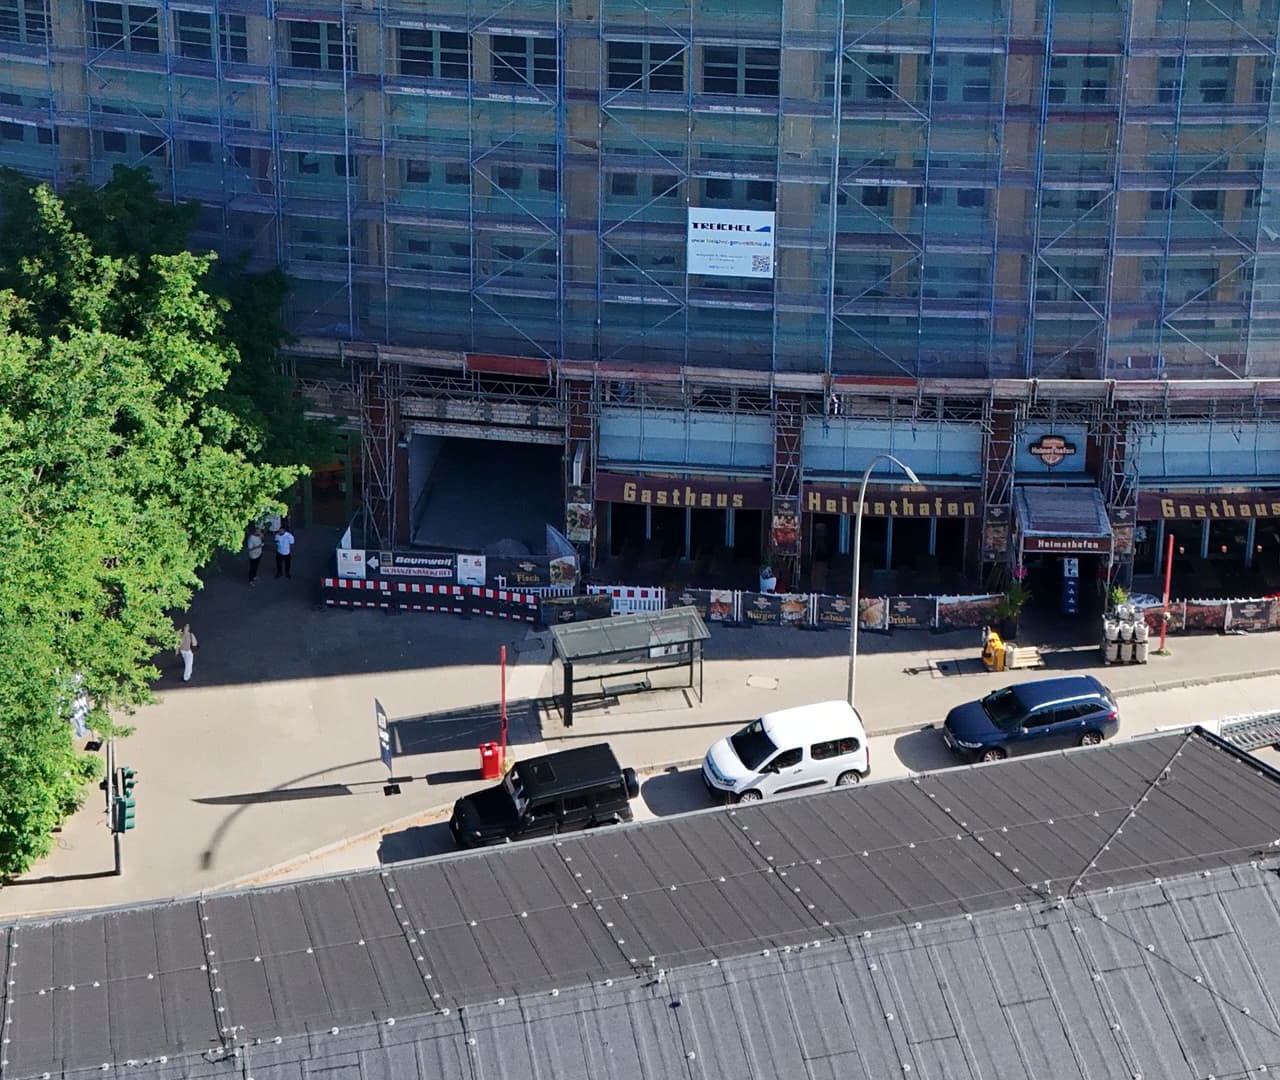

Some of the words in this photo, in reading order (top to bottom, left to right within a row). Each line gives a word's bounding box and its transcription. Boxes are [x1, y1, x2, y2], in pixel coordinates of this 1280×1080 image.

[691, 222, 752, 233] TREICHEL
[623, 482, 743, 508] Gasthaus
[1038, 539, 1099, 549] Heimathafen
